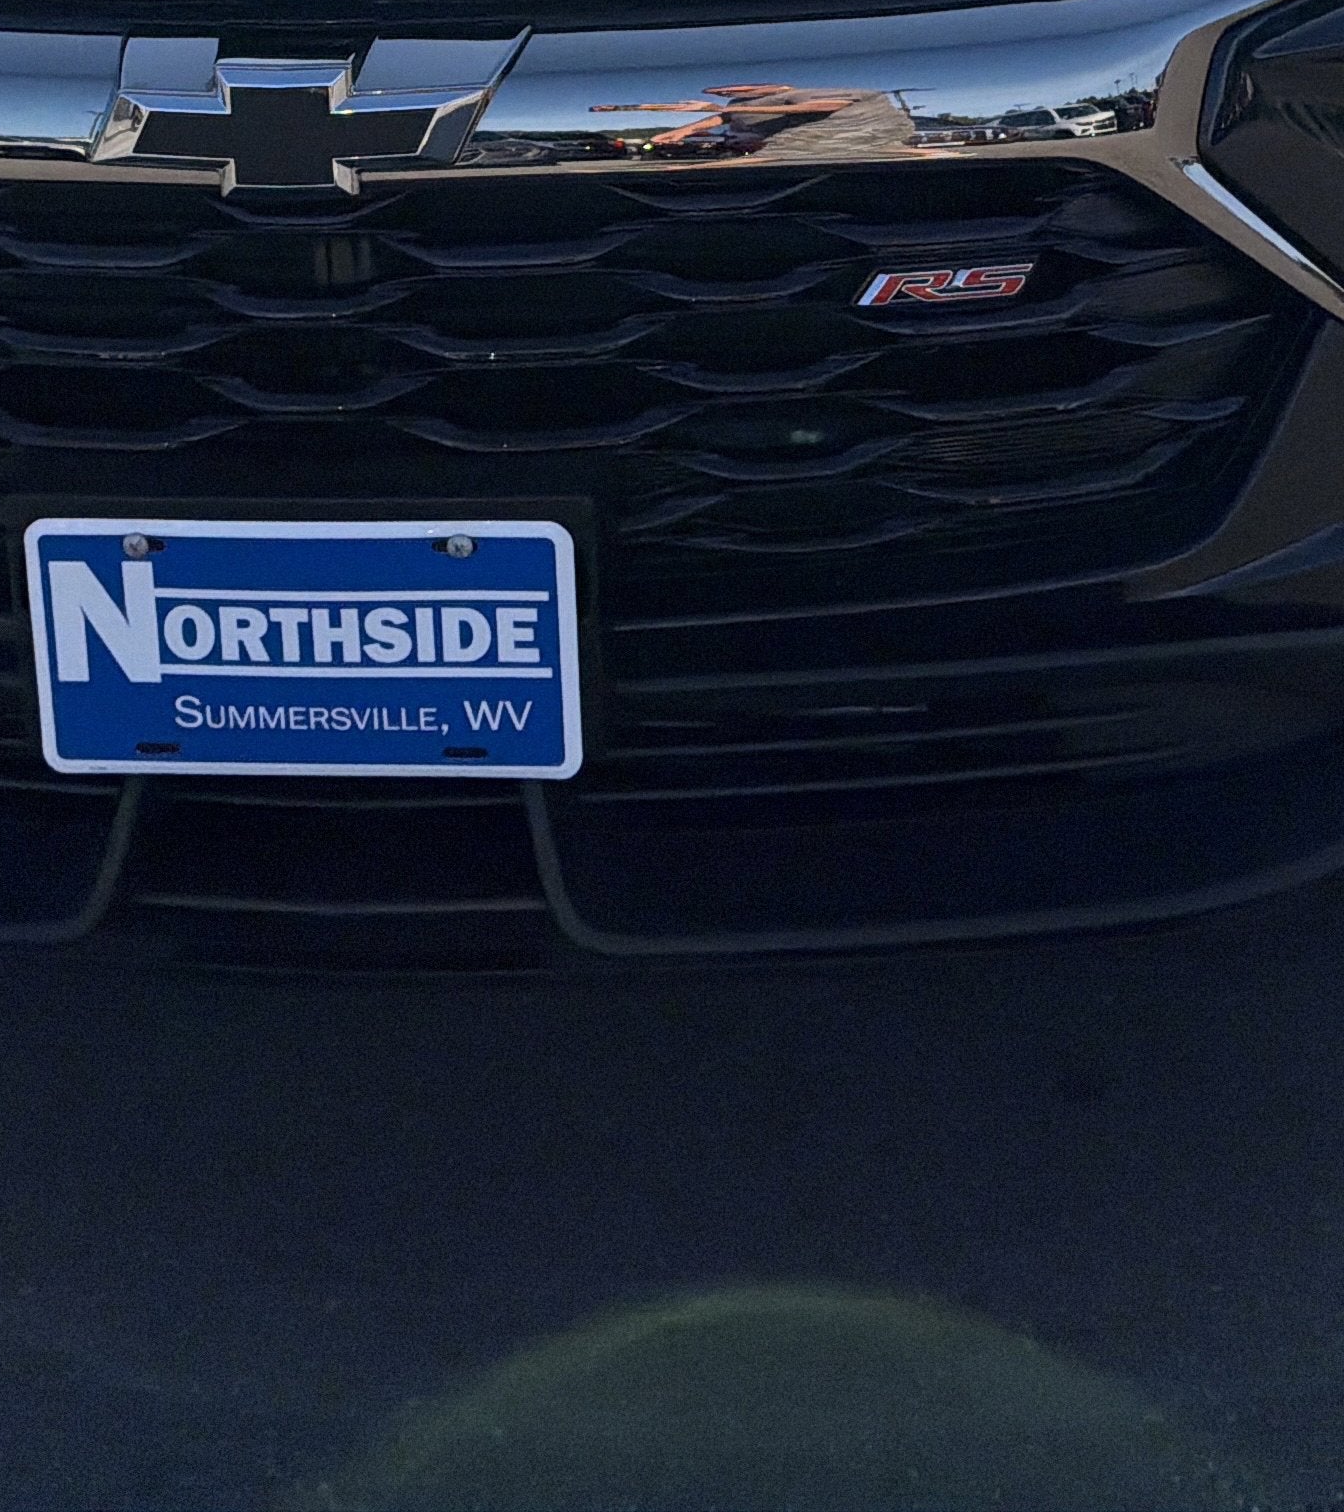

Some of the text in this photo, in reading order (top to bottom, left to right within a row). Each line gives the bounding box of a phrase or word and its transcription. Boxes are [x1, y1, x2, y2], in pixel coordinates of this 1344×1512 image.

[857, 263, 1034, 306] RS
[48, 560, 540, 683] NORTHSIDE
[174, 695, 533, 735] SUMMERSVILLE, WV
